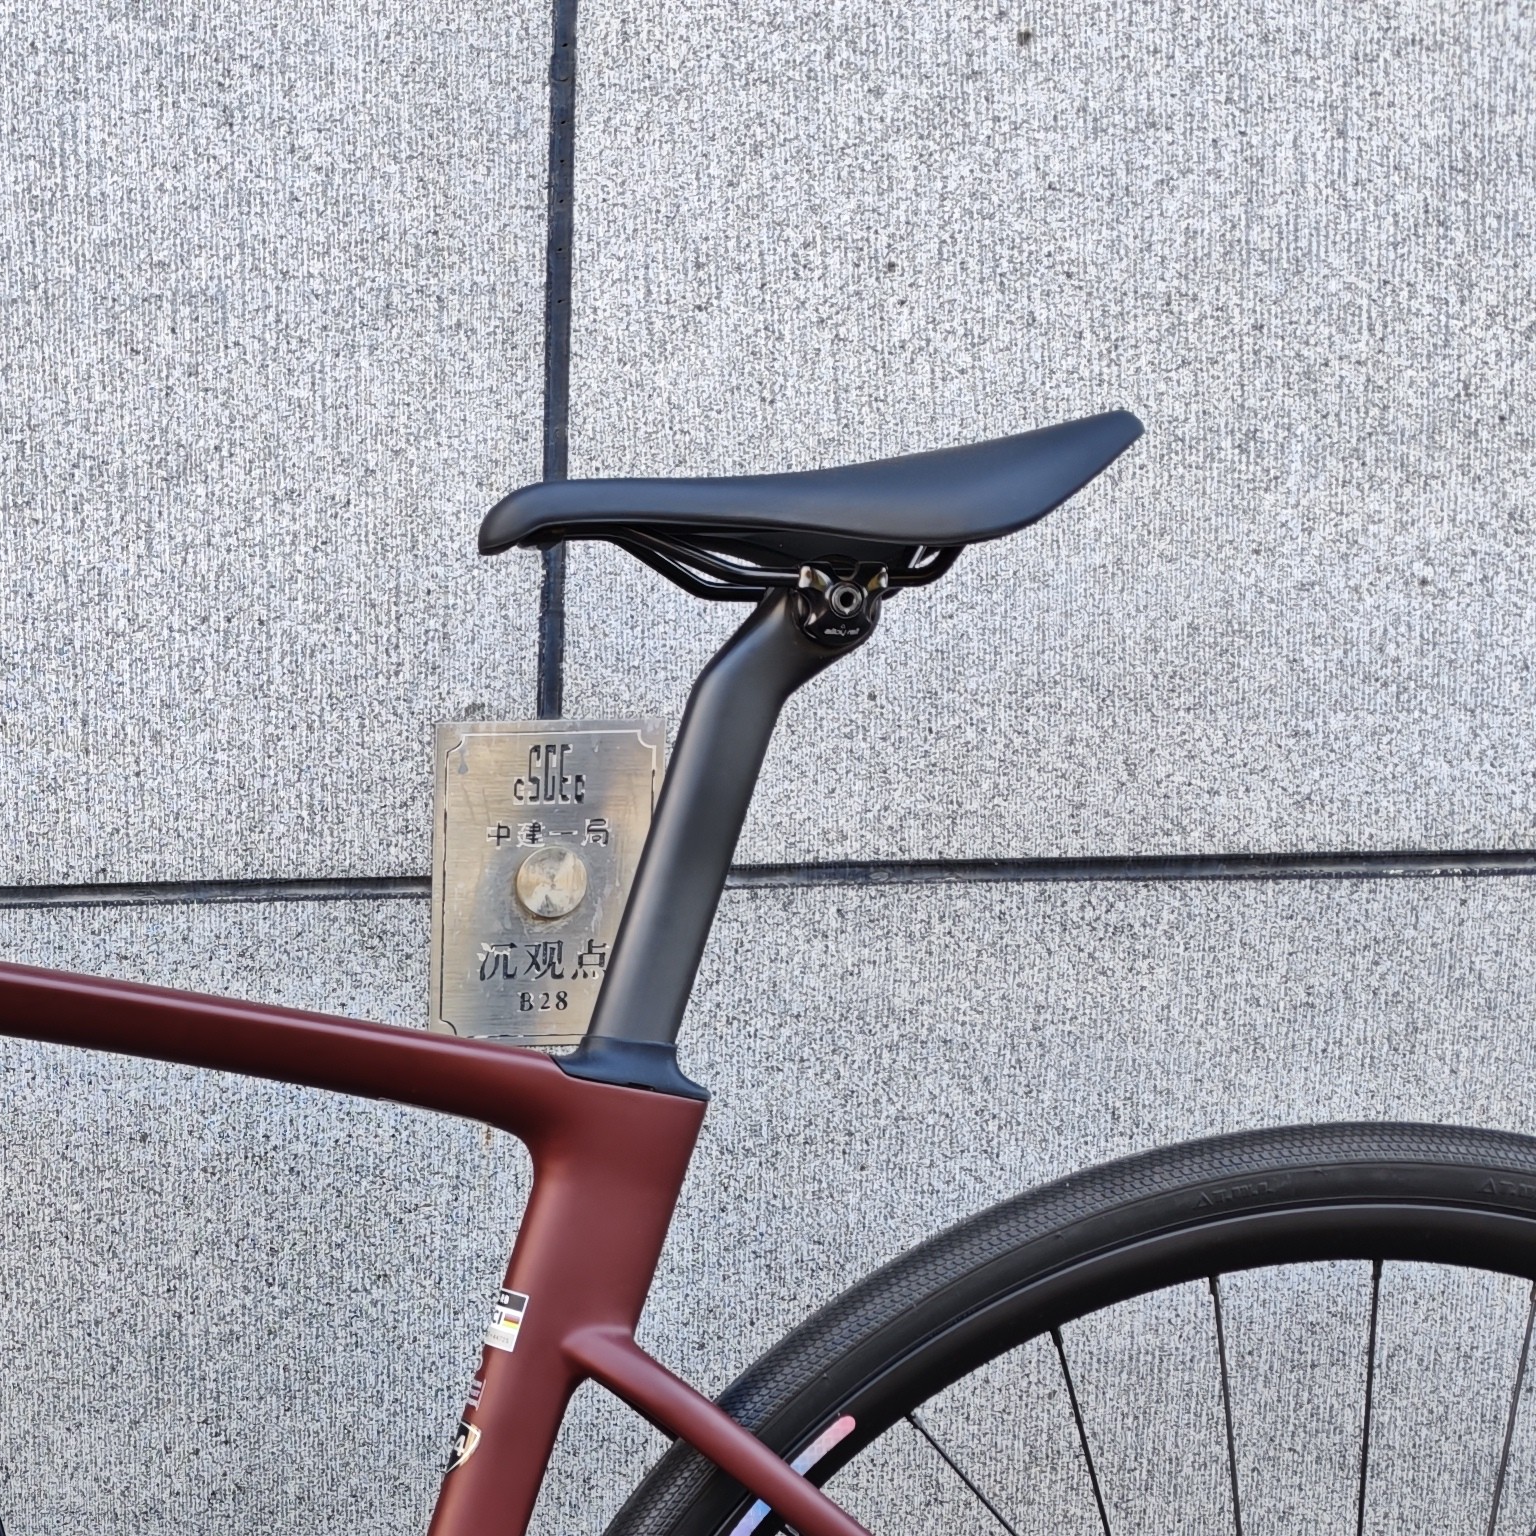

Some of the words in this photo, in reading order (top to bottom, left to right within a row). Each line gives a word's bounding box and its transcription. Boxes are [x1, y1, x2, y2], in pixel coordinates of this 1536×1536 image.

[485, 818, 612, 848] 中建一局
[519, 990, 569, 1012] B28
